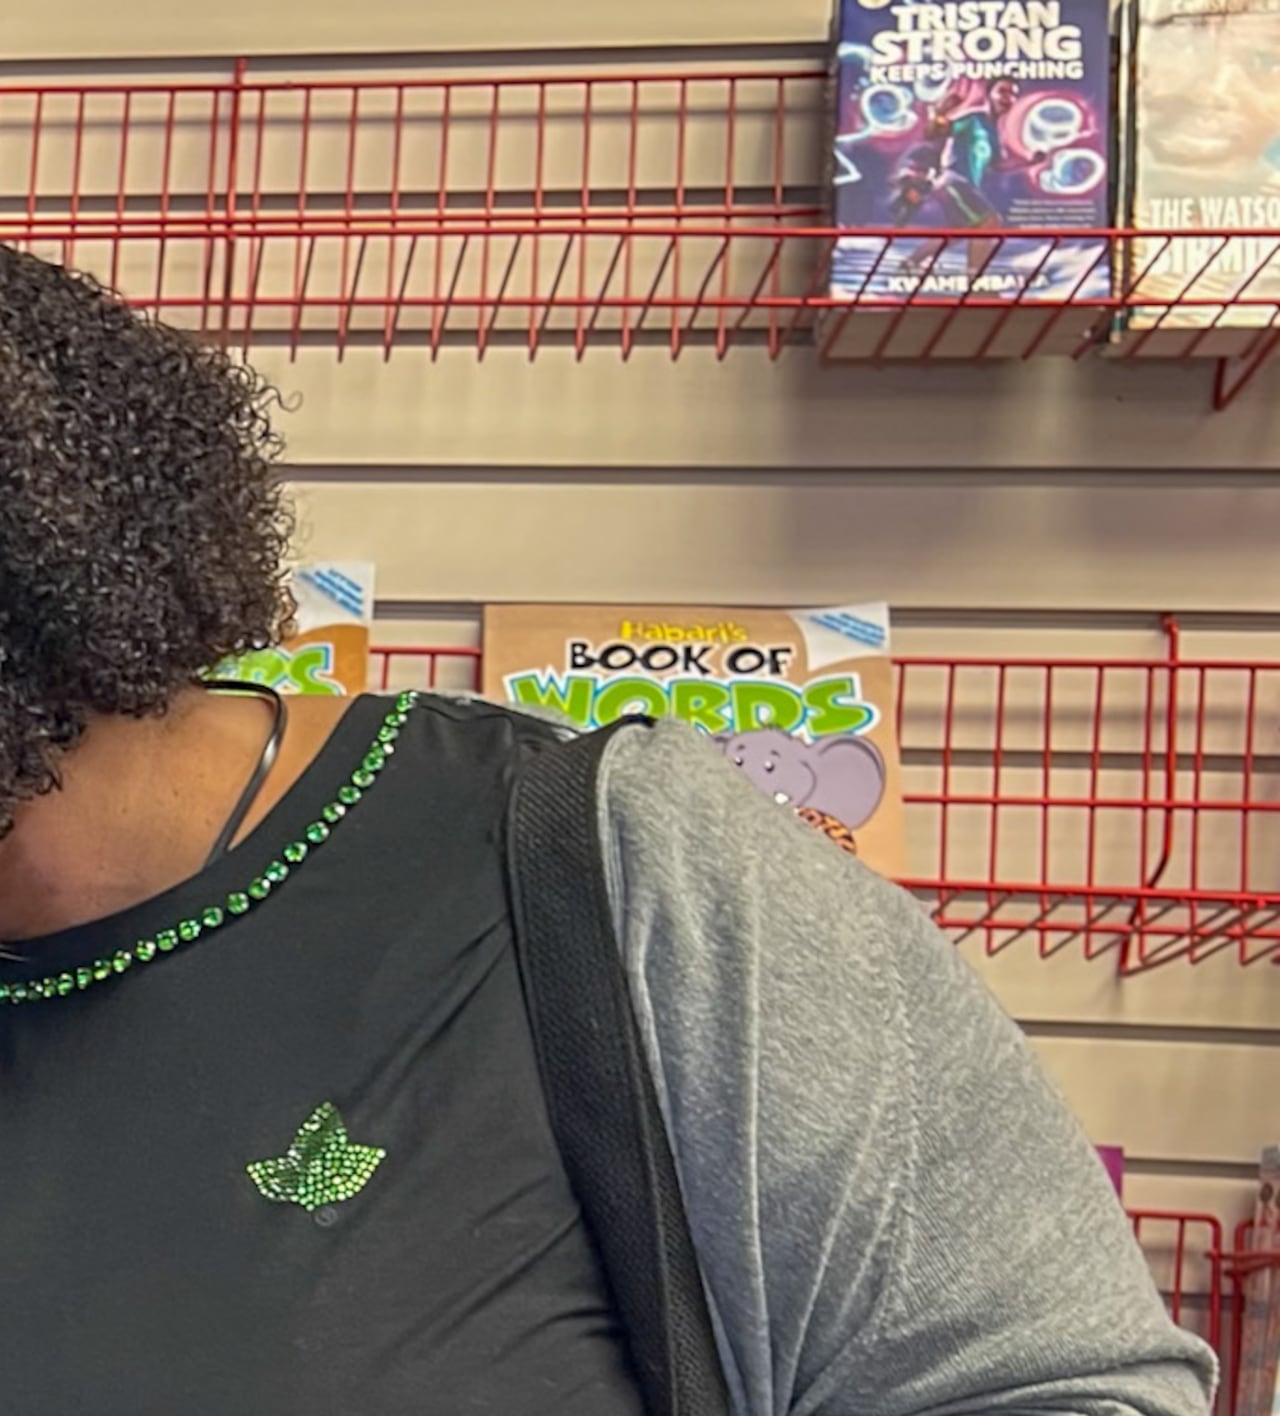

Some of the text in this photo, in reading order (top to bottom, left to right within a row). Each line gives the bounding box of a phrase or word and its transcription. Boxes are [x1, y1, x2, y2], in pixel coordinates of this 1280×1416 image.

[891, 0, 1061, 31] TRISTAN
[871, 25, 1083, 65] STRONG
[869, 60, 1085, 83] KEEPS PUNCHING
[1150, 197, 1195, 228] THE
[570, 642, 792, 675] BOOK OF
[508, 671, 875, 737] WORDS
